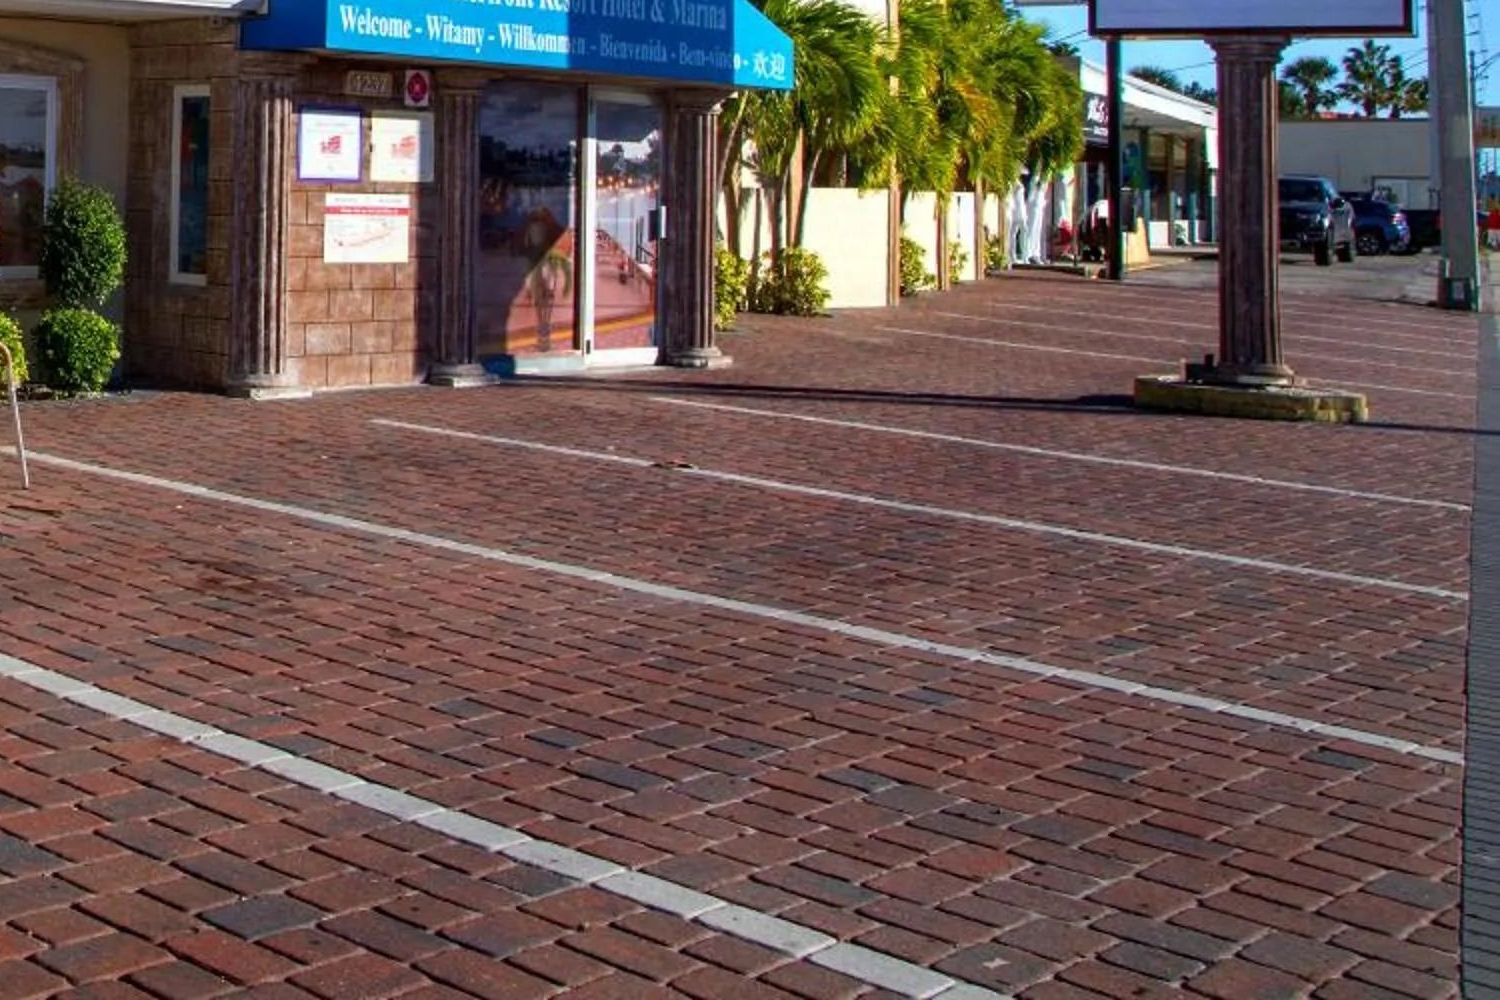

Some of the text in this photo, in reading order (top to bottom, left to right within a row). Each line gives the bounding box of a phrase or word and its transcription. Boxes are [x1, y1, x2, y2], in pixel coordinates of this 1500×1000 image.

[340, 4, 412, 39] Welcome
[426, 14, 484, 54] Witamy
[499, 23, 586, 56] Willkommen
[600, 33, 667, 62] Bienvenida
